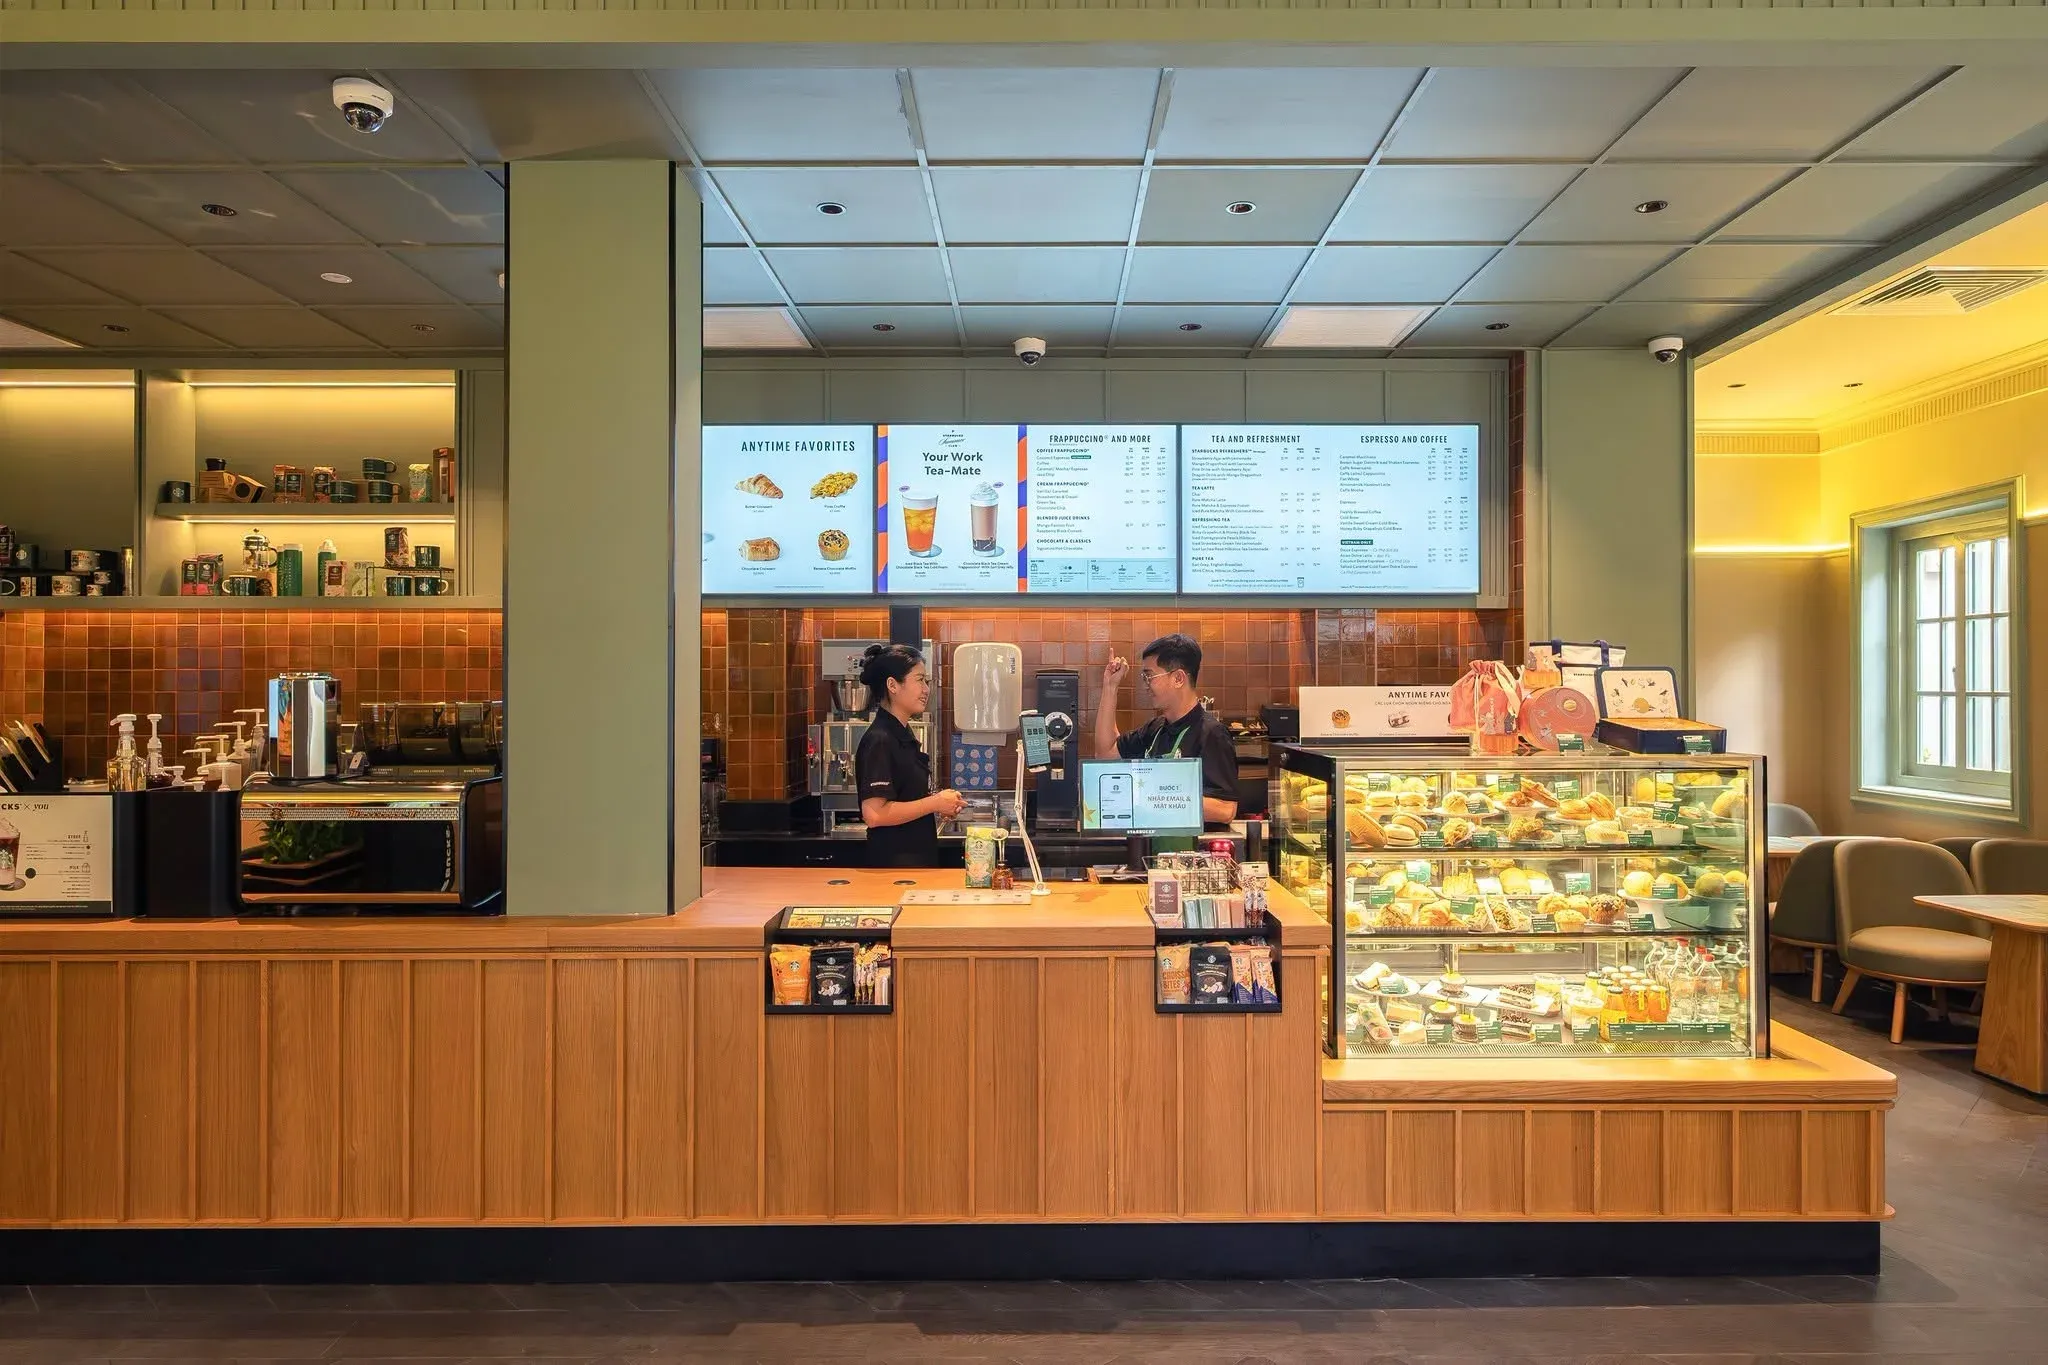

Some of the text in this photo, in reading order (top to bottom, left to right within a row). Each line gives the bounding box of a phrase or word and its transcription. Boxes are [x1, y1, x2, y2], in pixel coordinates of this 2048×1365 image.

[1111, 435, 1126, 443] AND
[1130, 435, 1151, 443] MORE
[1212, 435, 1300, 443] TEA AND REFRESHMENT
[1361, 435, 1447, 443] ESPRESSO AND COFFEE
[742, 441, 855, 451] ANYTIME FAVORITES
[922, 452, 983, 462] Your Work
[925, 466, 981, 475] Tea-Mate
[33, 803, 49, 811] you
